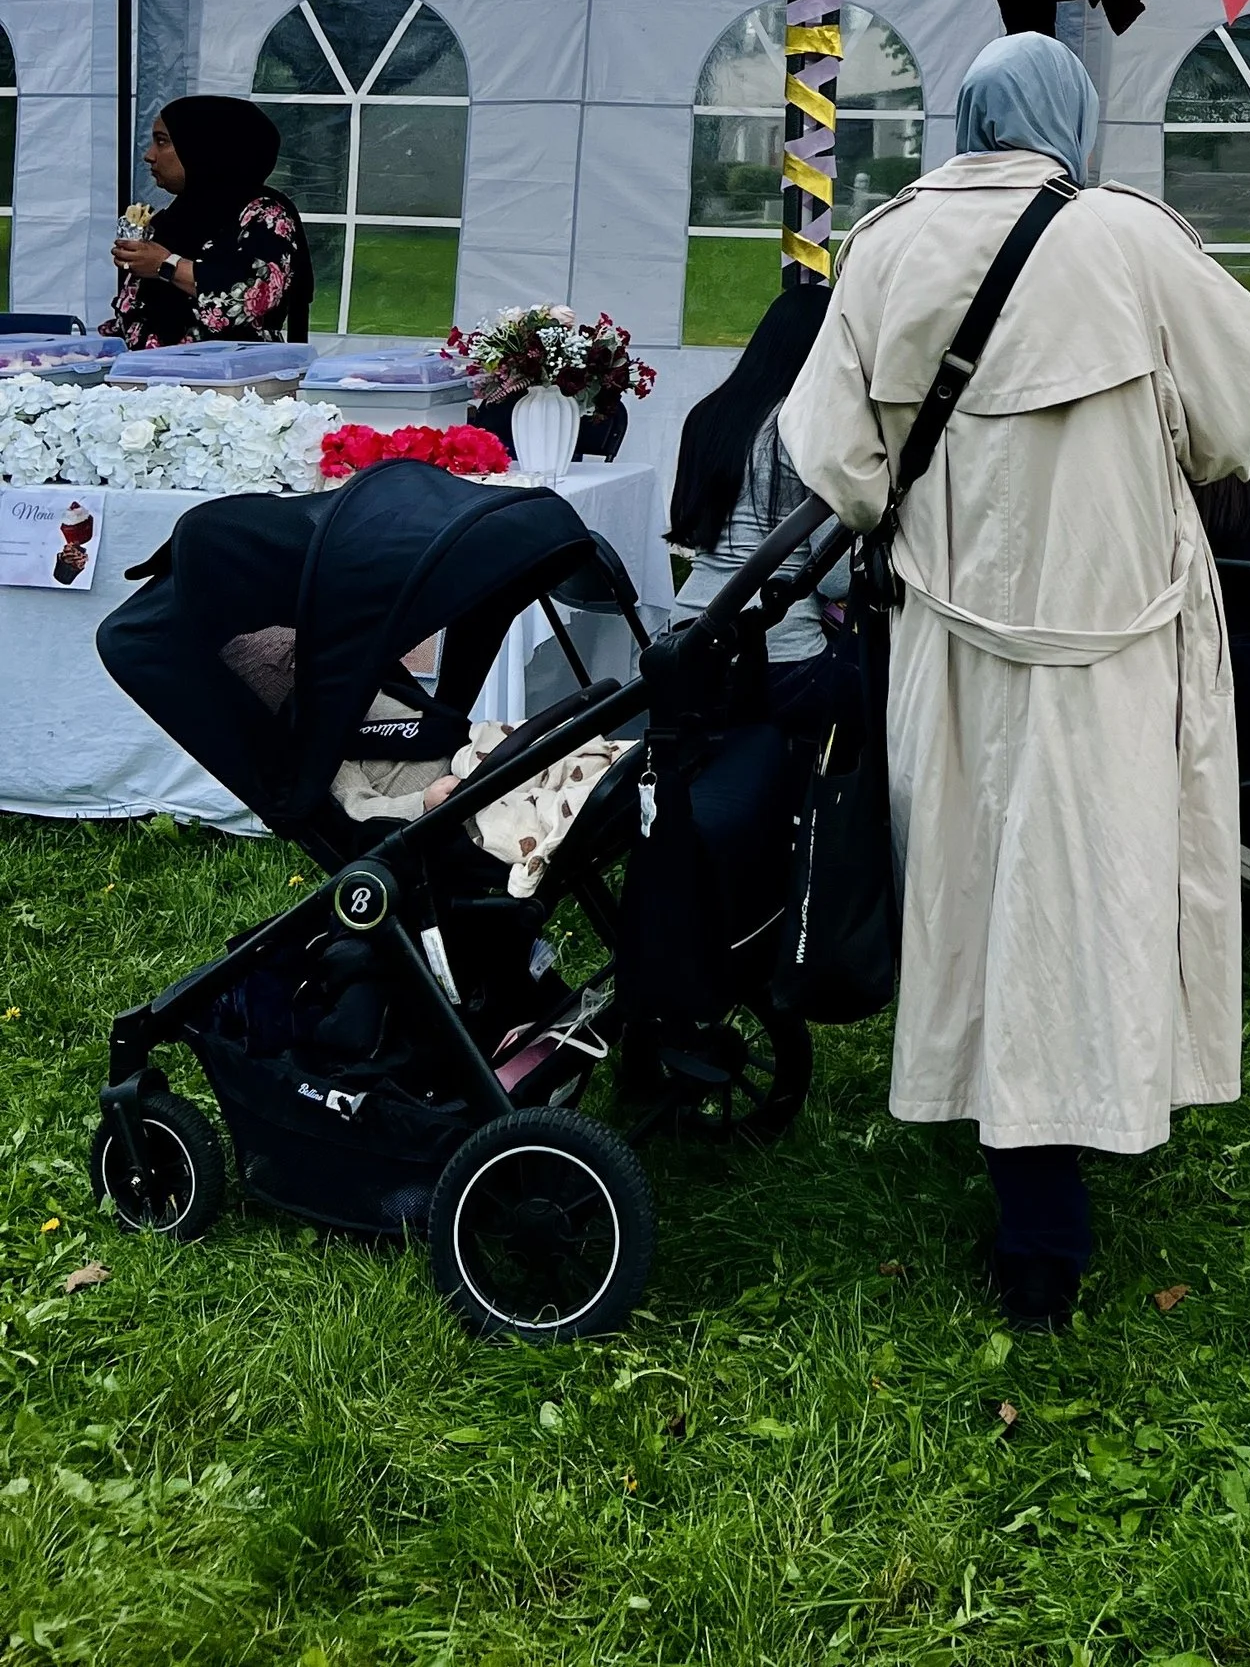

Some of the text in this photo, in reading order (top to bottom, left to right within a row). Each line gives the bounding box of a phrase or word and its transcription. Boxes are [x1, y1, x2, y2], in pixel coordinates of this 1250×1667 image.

[12, 501, 56, 522] Menu
[360, 721, 420, 739] Bellino
[351, 887, 372, 914] B
